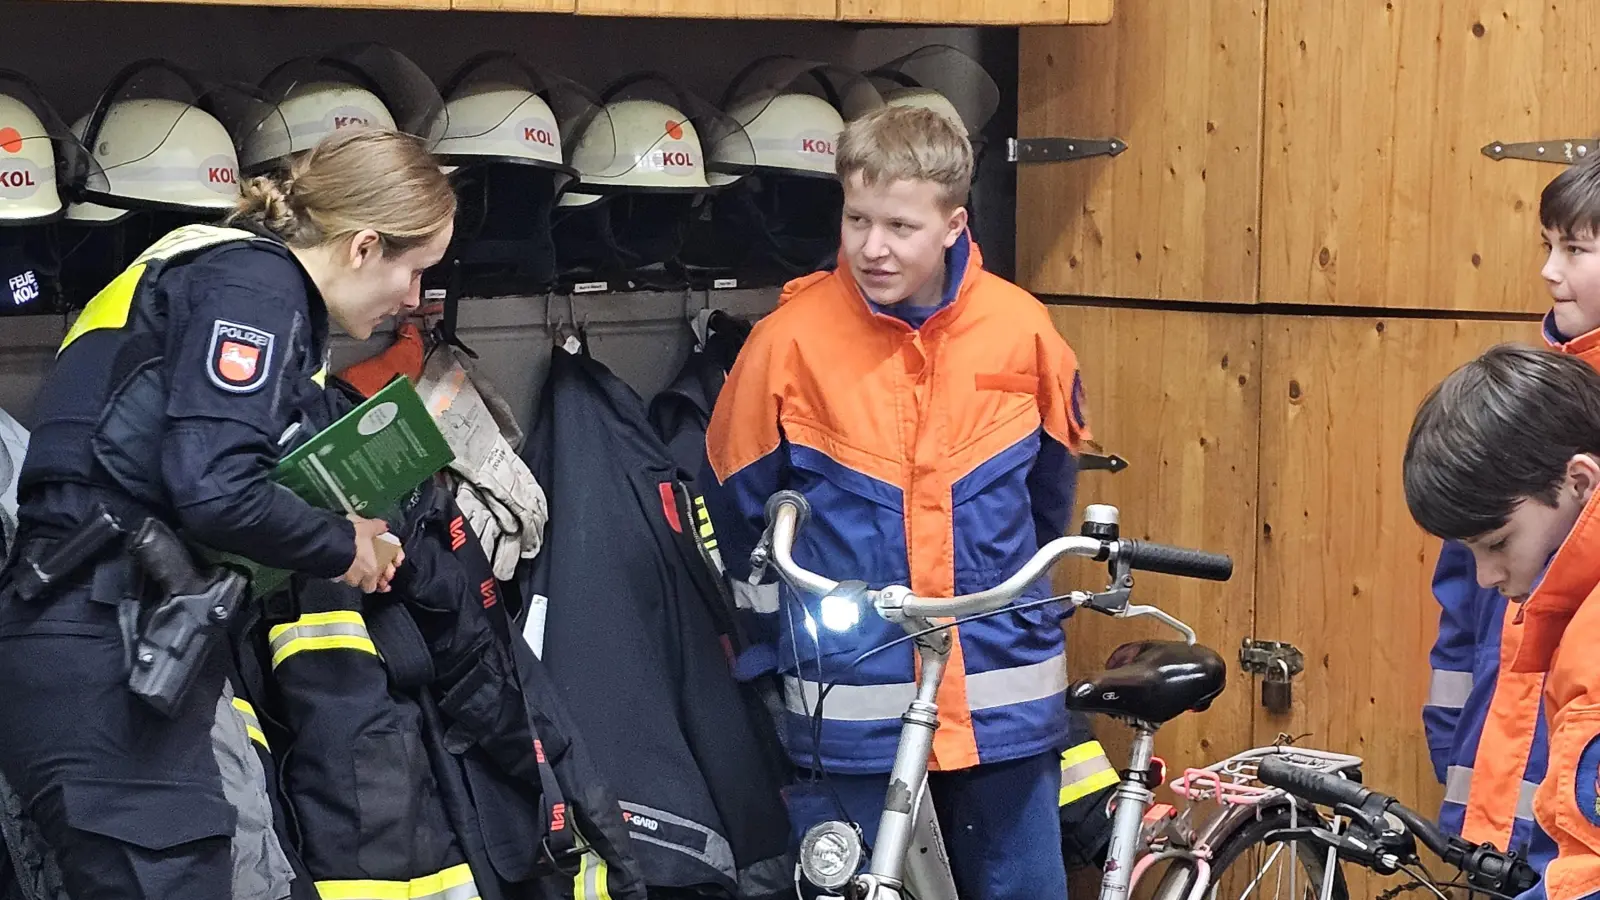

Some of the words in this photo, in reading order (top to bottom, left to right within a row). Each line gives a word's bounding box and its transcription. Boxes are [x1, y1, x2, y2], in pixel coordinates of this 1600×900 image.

[524, 127, 554, 147] KOL
[803, 138, 834, 156] KOL
[662, 152, 693, 167] KOL
[209, 168, 236, 185] KOL
